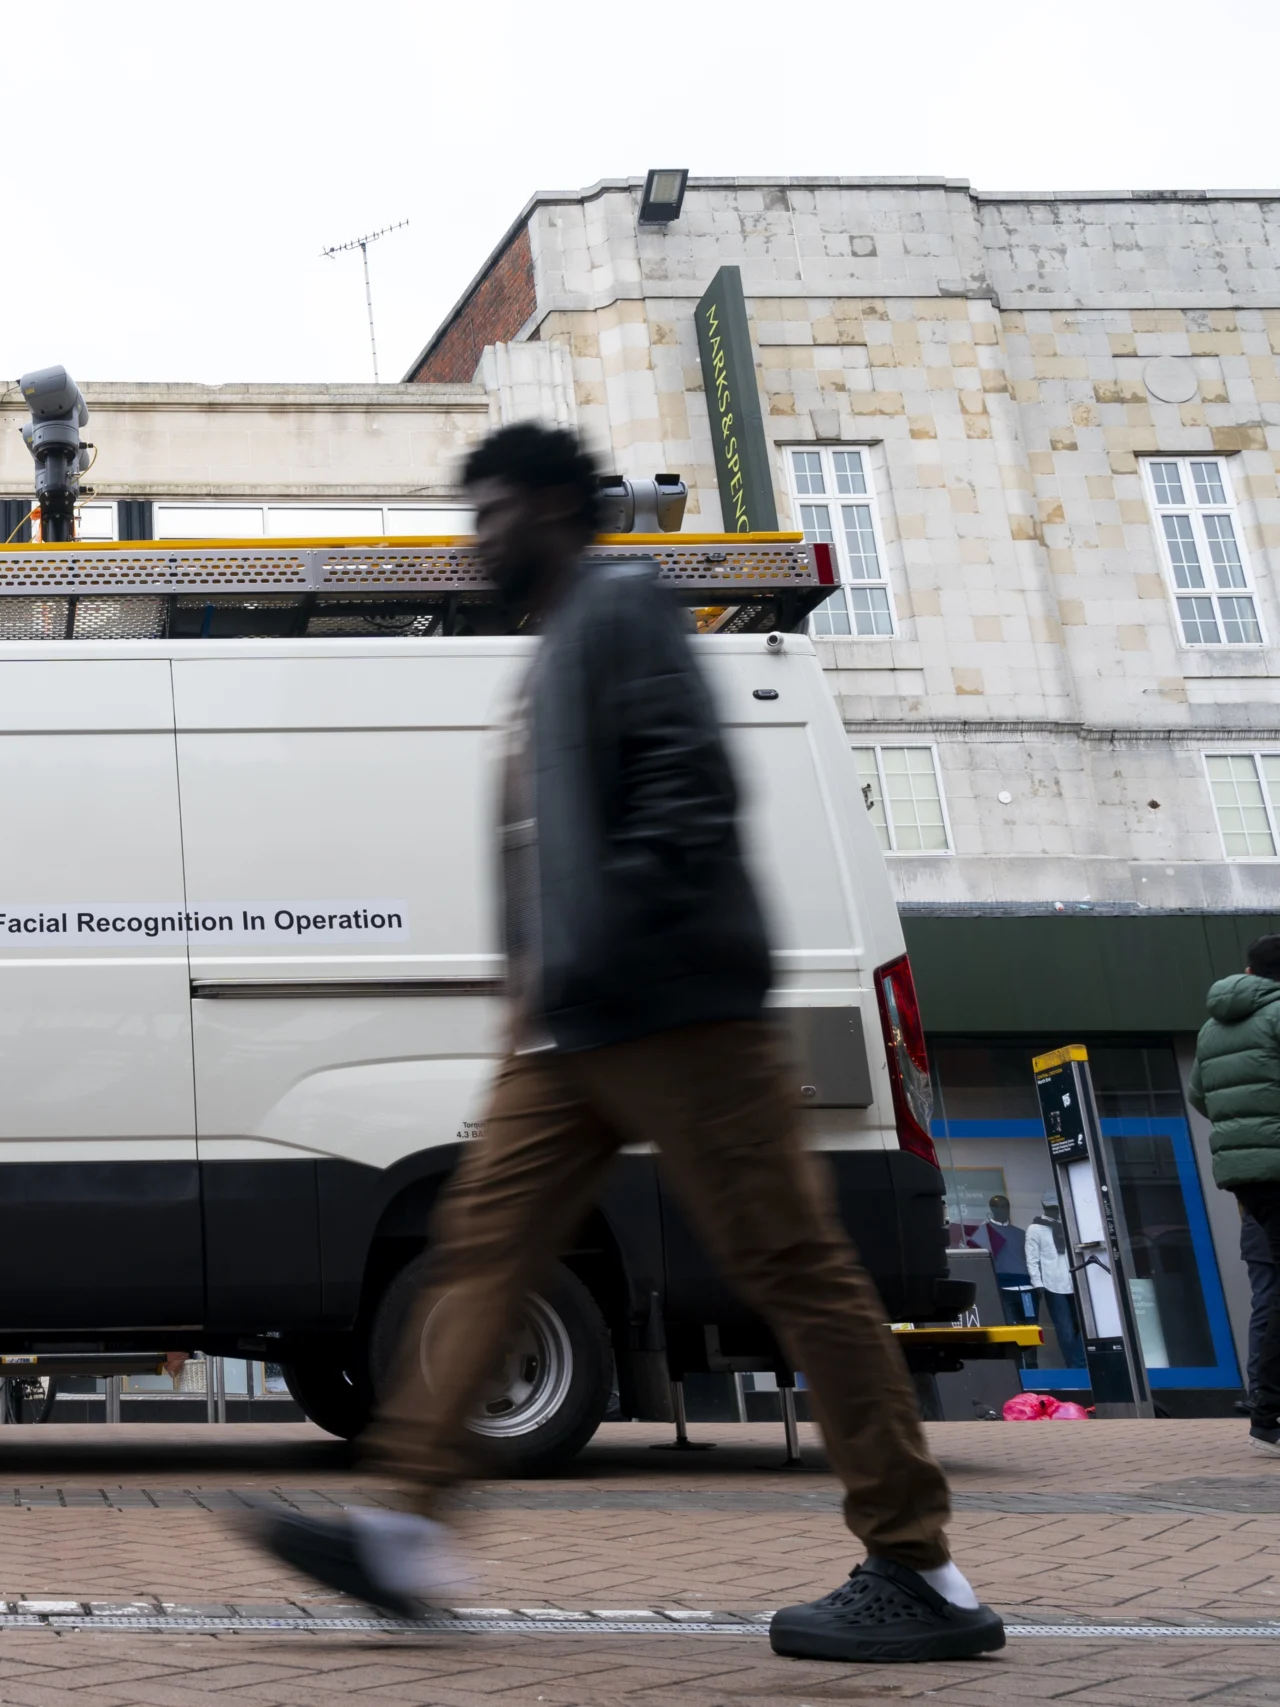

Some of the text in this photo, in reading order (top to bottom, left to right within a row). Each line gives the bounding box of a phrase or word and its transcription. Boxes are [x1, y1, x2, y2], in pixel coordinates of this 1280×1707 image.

[706, 303, 731, 413] MARKS
[721, 413, 734, 440] &
[76, 911, 234, 937] Recognition
[241, 910, 266, 931] In
[274, 908, 403, 935] Operation
